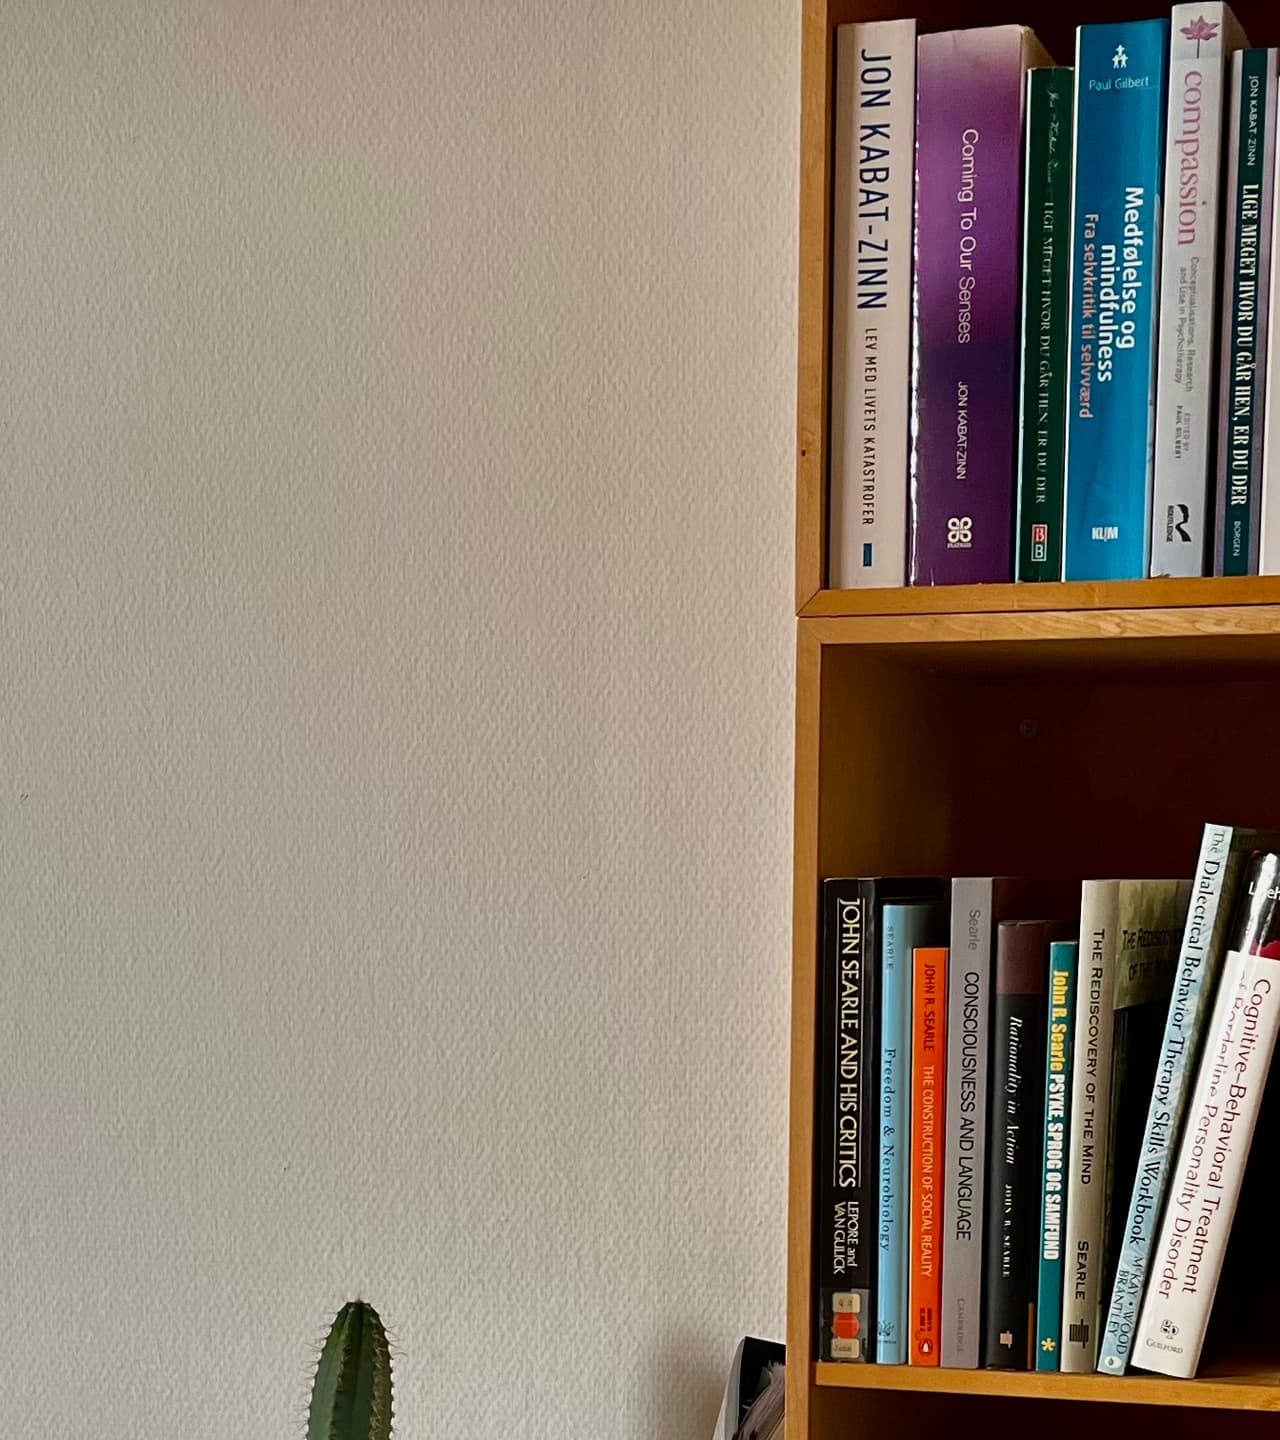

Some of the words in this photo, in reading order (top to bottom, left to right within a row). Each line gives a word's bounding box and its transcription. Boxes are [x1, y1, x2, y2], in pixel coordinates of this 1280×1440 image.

[860, 48, 892, 109] JON
[1089, 78, 1116, 92] Paul
[1120, 75, 1150, 91] Gilbert
[958, 129, 979, 203] Coming
[1177, 71, 1204, 246] compassion
[856, 122, 892, 310] KABAT-ZINN
[962, 208, 977, 232] To
[1084, 213, 1097, 237] Fra
[959, 238, 975, 272] Our
[1122, 187, 1144, 315] Medfølelse
[958, 277, 973, 344] Senses
[1082, 241, 1096, 323] selvkritik
[866, 328, 878, 352] LEV
[1081, 327, 1093, 345] til
[1097, 244, 1117, 383] mindfulness
[1116, 322, 1135, 350] og
[865, 357, 878, 383] MED
[1079, 350, 1094, 419] selvværd
[864, 388, 878, 431] LIVETS
[862, 437, 877, 526] KATASTROFER
[839, 898, 860, 954] JOHN
[841, 960, 859, 1029] SEARLE
[840, 1033, 858, 1079] AND
[960, 971, 981, 1113] CONSCIOUSNESS
[839, 1083, 858, 1111] HIS
[838, 1116, 857, 1188] CRITICS
[959, 1118, 975, 1151] AND
[955, 1155, 973, 1242] LANGUAGE
